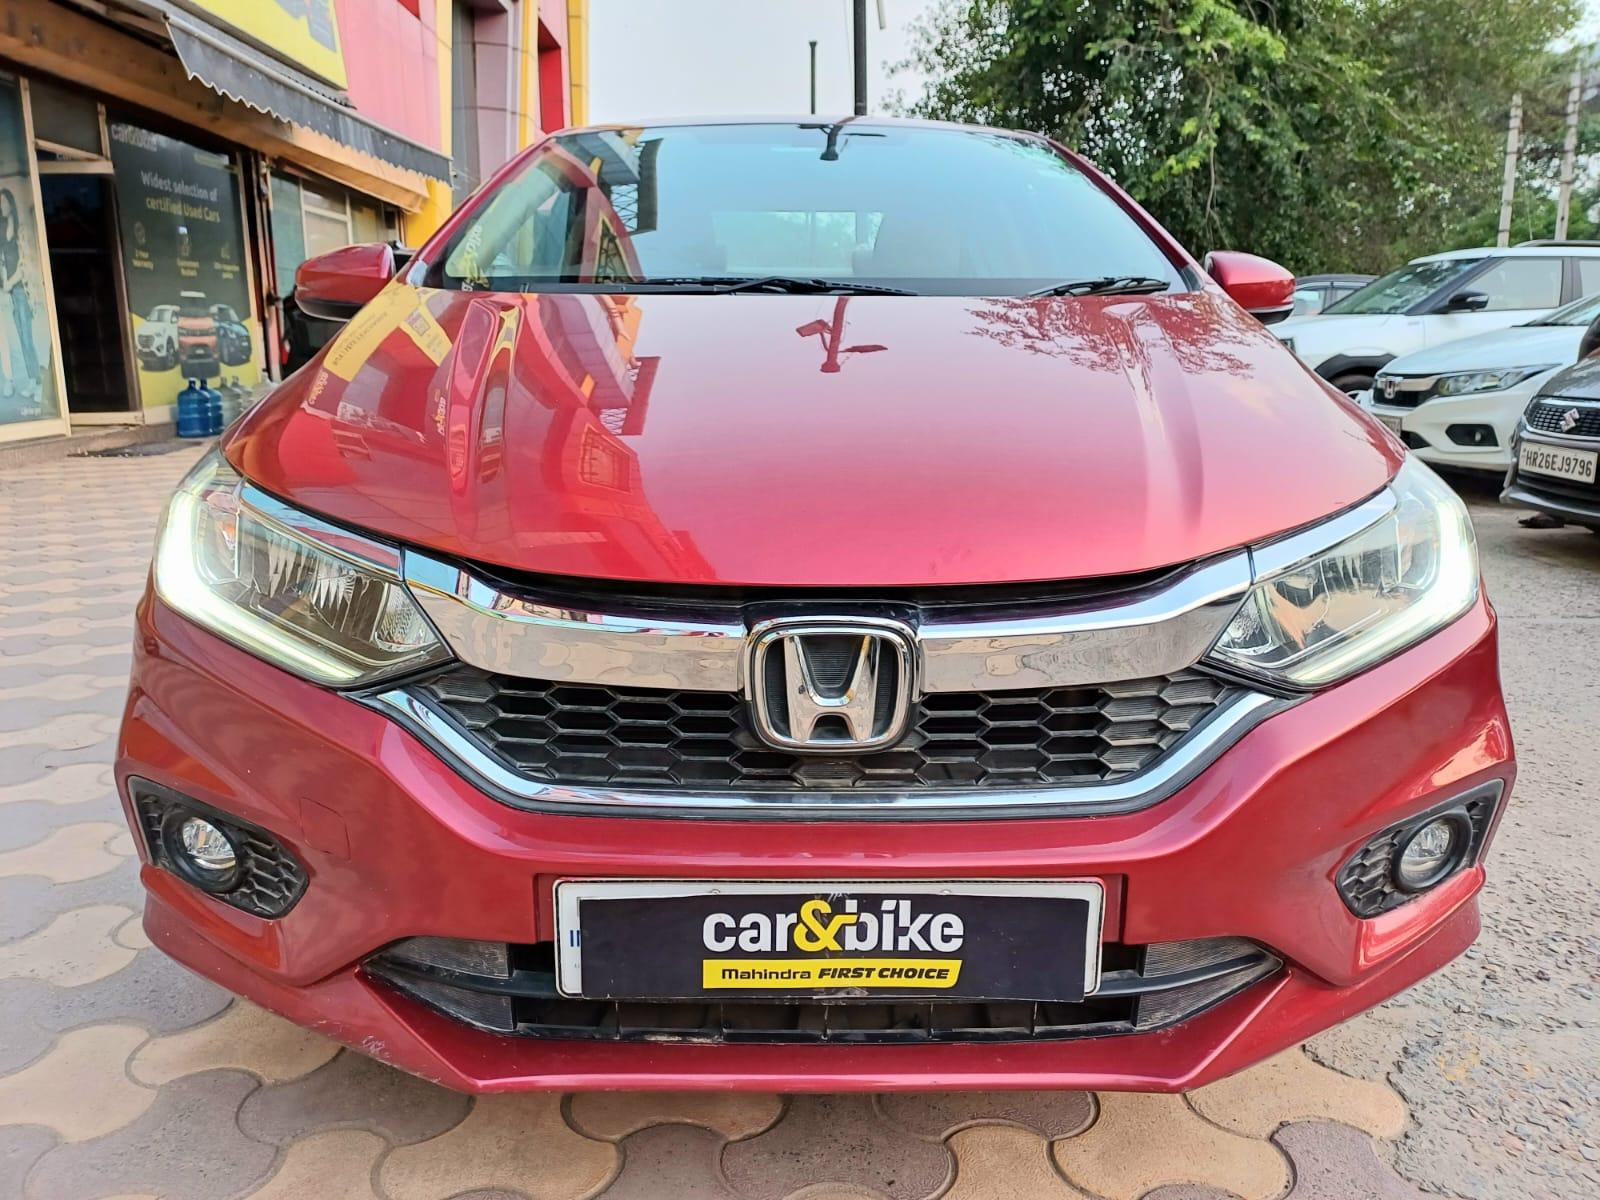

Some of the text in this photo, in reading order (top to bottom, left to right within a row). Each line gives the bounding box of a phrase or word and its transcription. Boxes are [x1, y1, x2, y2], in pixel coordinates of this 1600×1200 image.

[141, 170, 218, 202] Widest selection of
[145, 196, 220, 223] certified Used Cars
[1525, 450, 1593, 477] HR26EJ9796
[702, 899, 964, 952] car&bike
[721, 967, 950, 980] Mahindra FIRST CHOICE
